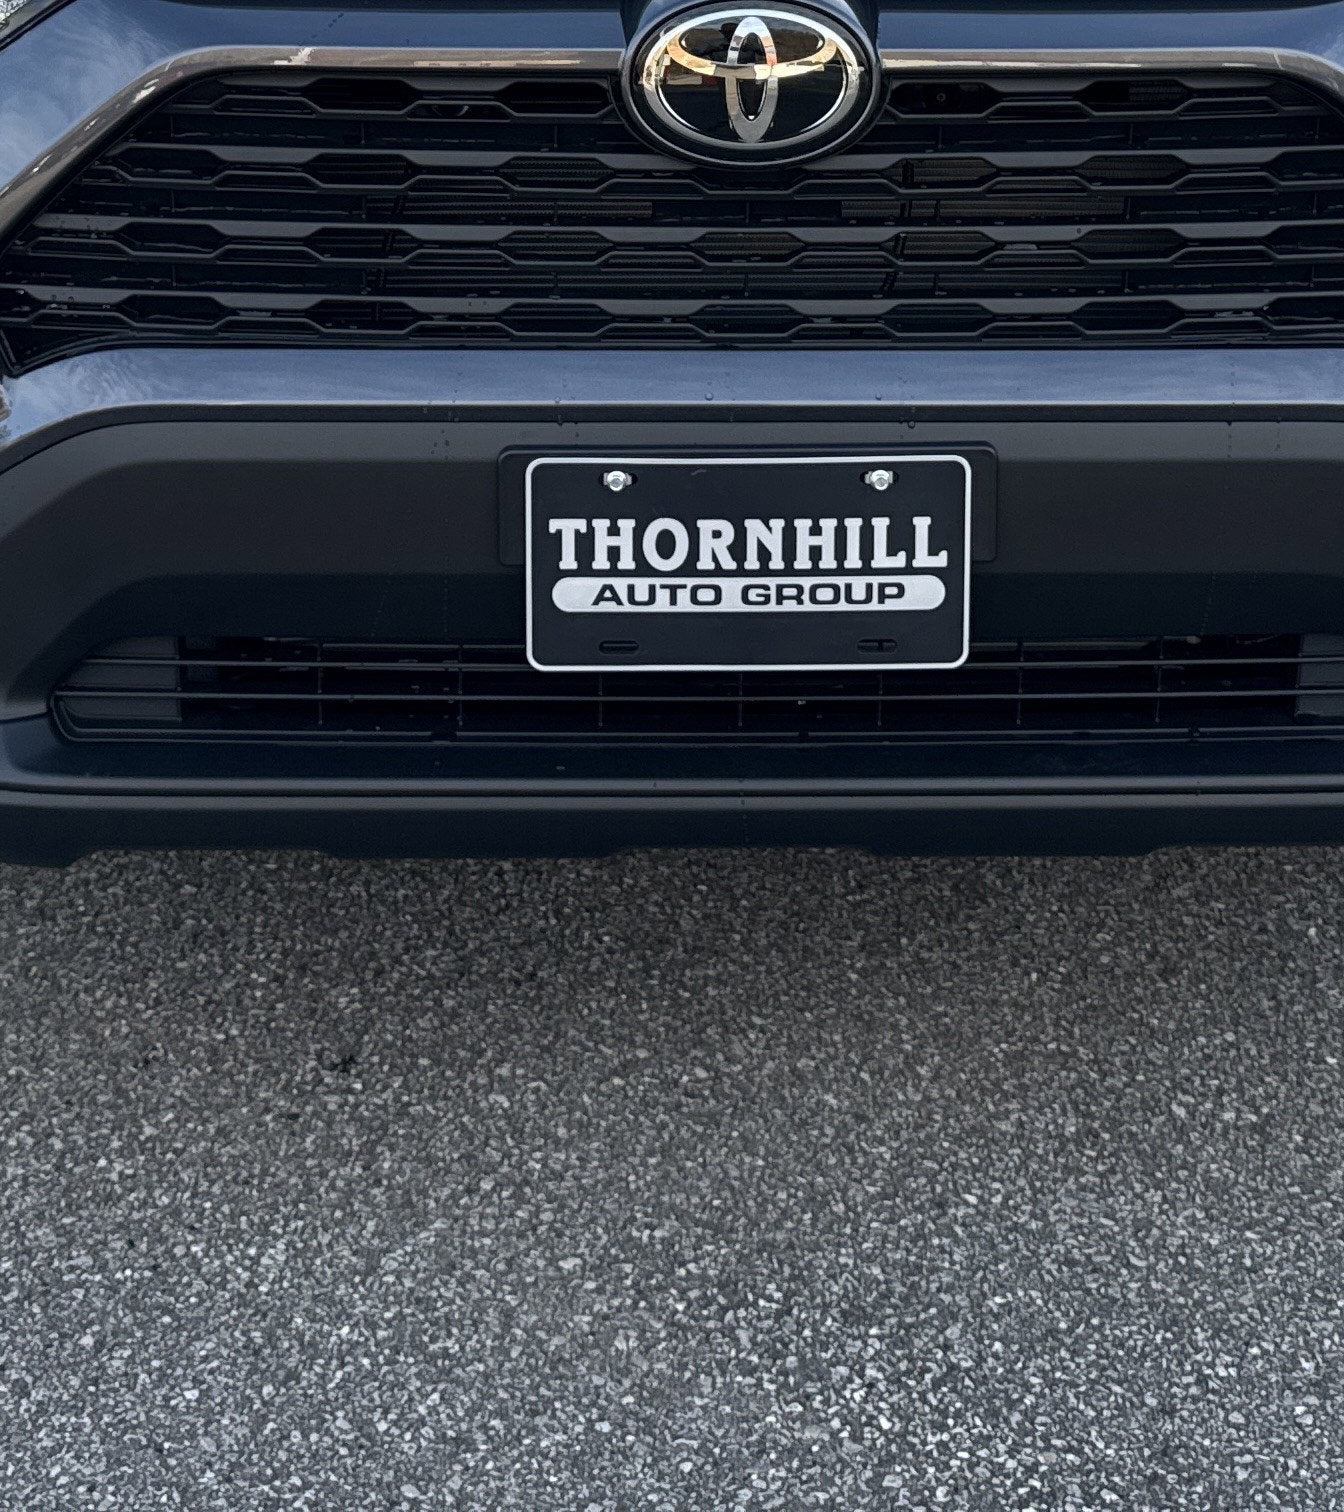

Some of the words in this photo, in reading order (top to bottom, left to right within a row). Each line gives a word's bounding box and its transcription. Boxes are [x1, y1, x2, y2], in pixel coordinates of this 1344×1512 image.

[548, 516, 949, 572] THORNHILL
[591, 583, 723, 607] AUTO
[741, 581, 906, 606] GROUP
